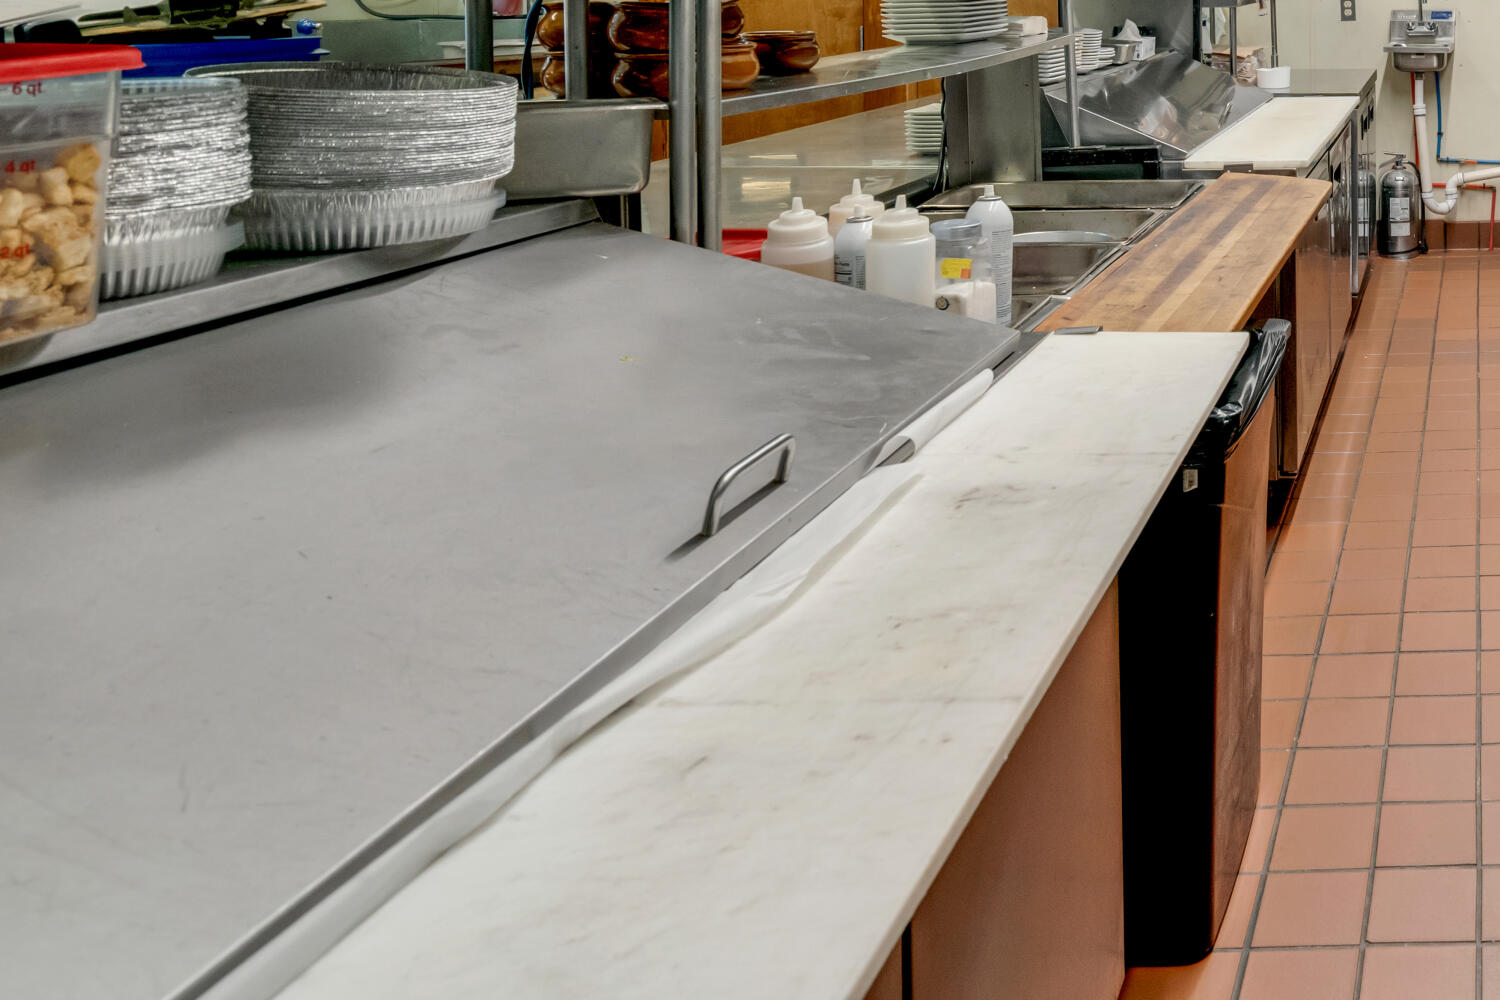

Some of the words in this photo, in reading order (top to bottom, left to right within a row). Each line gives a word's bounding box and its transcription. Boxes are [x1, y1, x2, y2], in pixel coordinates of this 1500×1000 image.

[12, 82, 22, 95] 6
[26, 82, 42, 96] qt
[5, 161, 15, 173] 4
[19, 160, 35, 174] qt
[13, 244, 30, 259] qt
